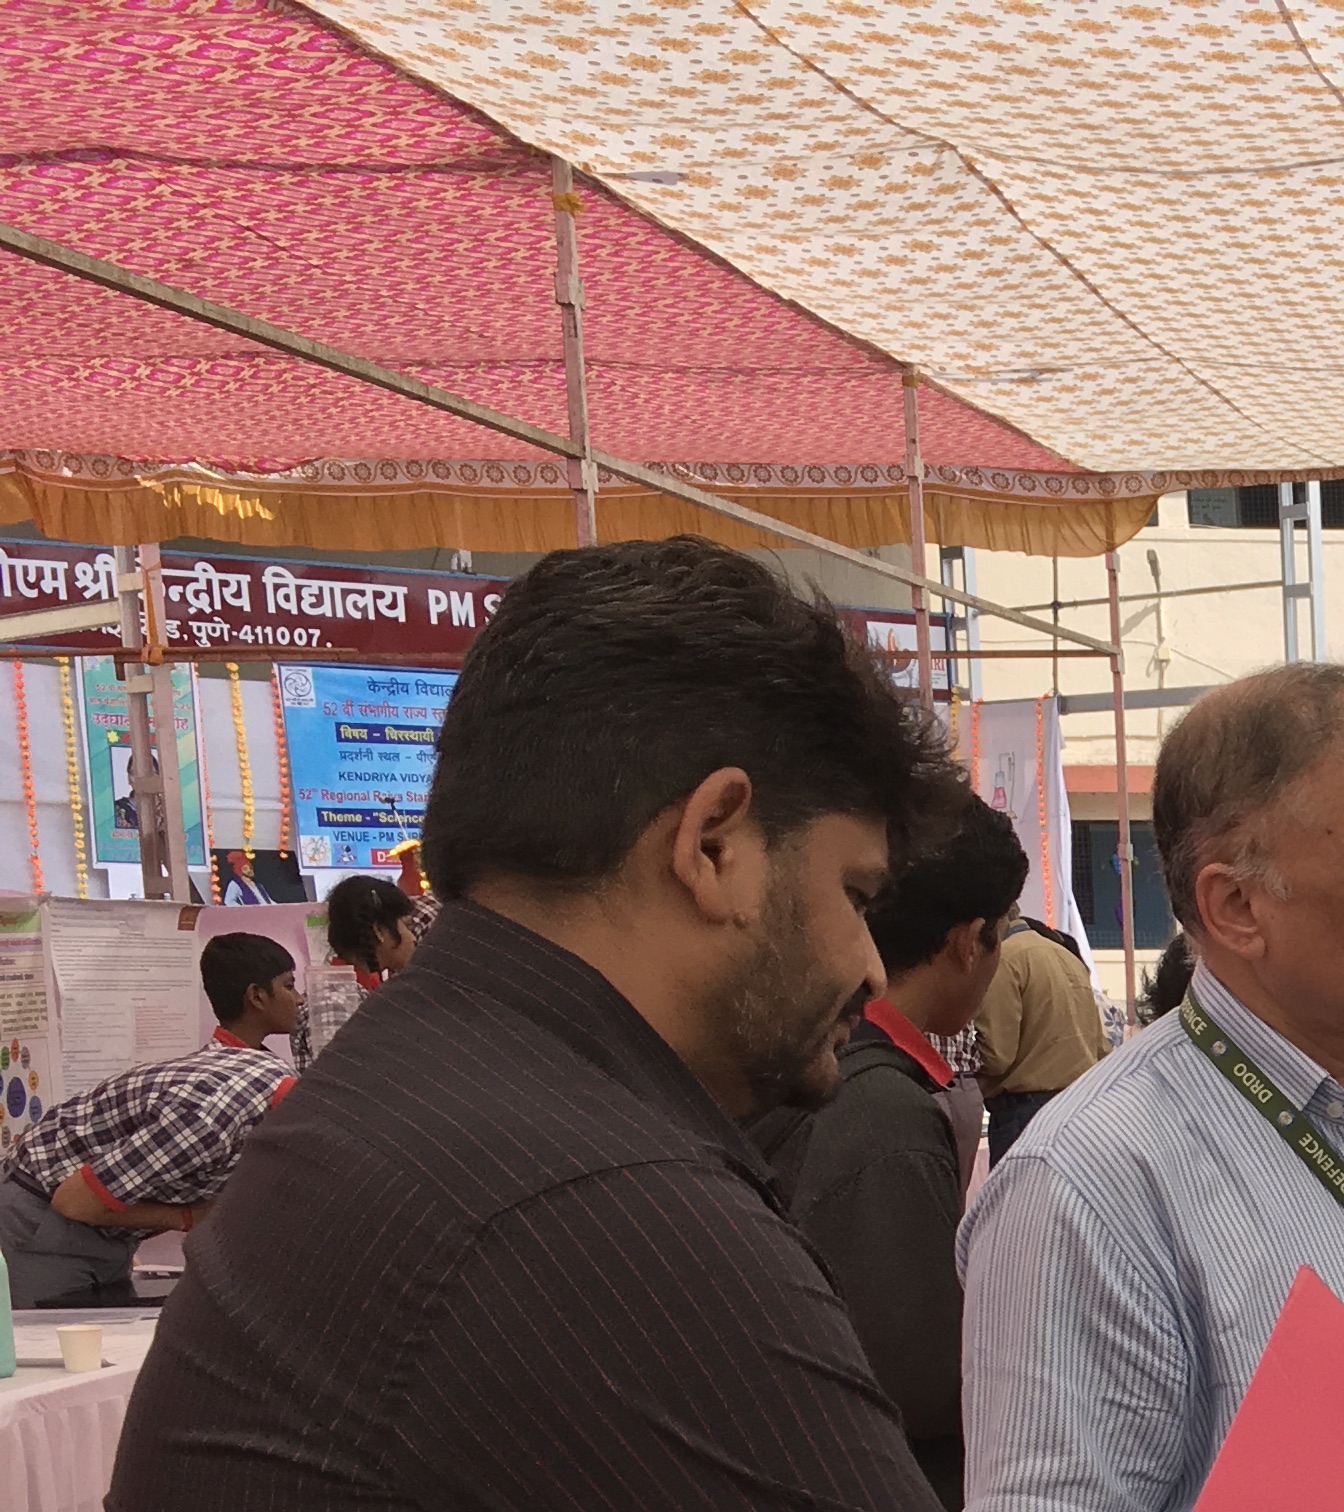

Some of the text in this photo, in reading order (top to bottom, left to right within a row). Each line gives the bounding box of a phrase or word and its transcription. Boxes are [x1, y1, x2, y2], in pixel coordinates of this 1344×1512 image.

[262, 566, 408, 622] विद्यालय
[428, 592, 476, 627] PM
[367, 675, 410, 697] केन्द्रीय
[338, 771, 397, 782] KENDRIYA
[321, 789, 369, 803] Regional
[322, 811, 362, 823] Theme
[333, 830, 369, 842] VENUE
[1181, 998, 1273, 1104] FENCE DRDO
